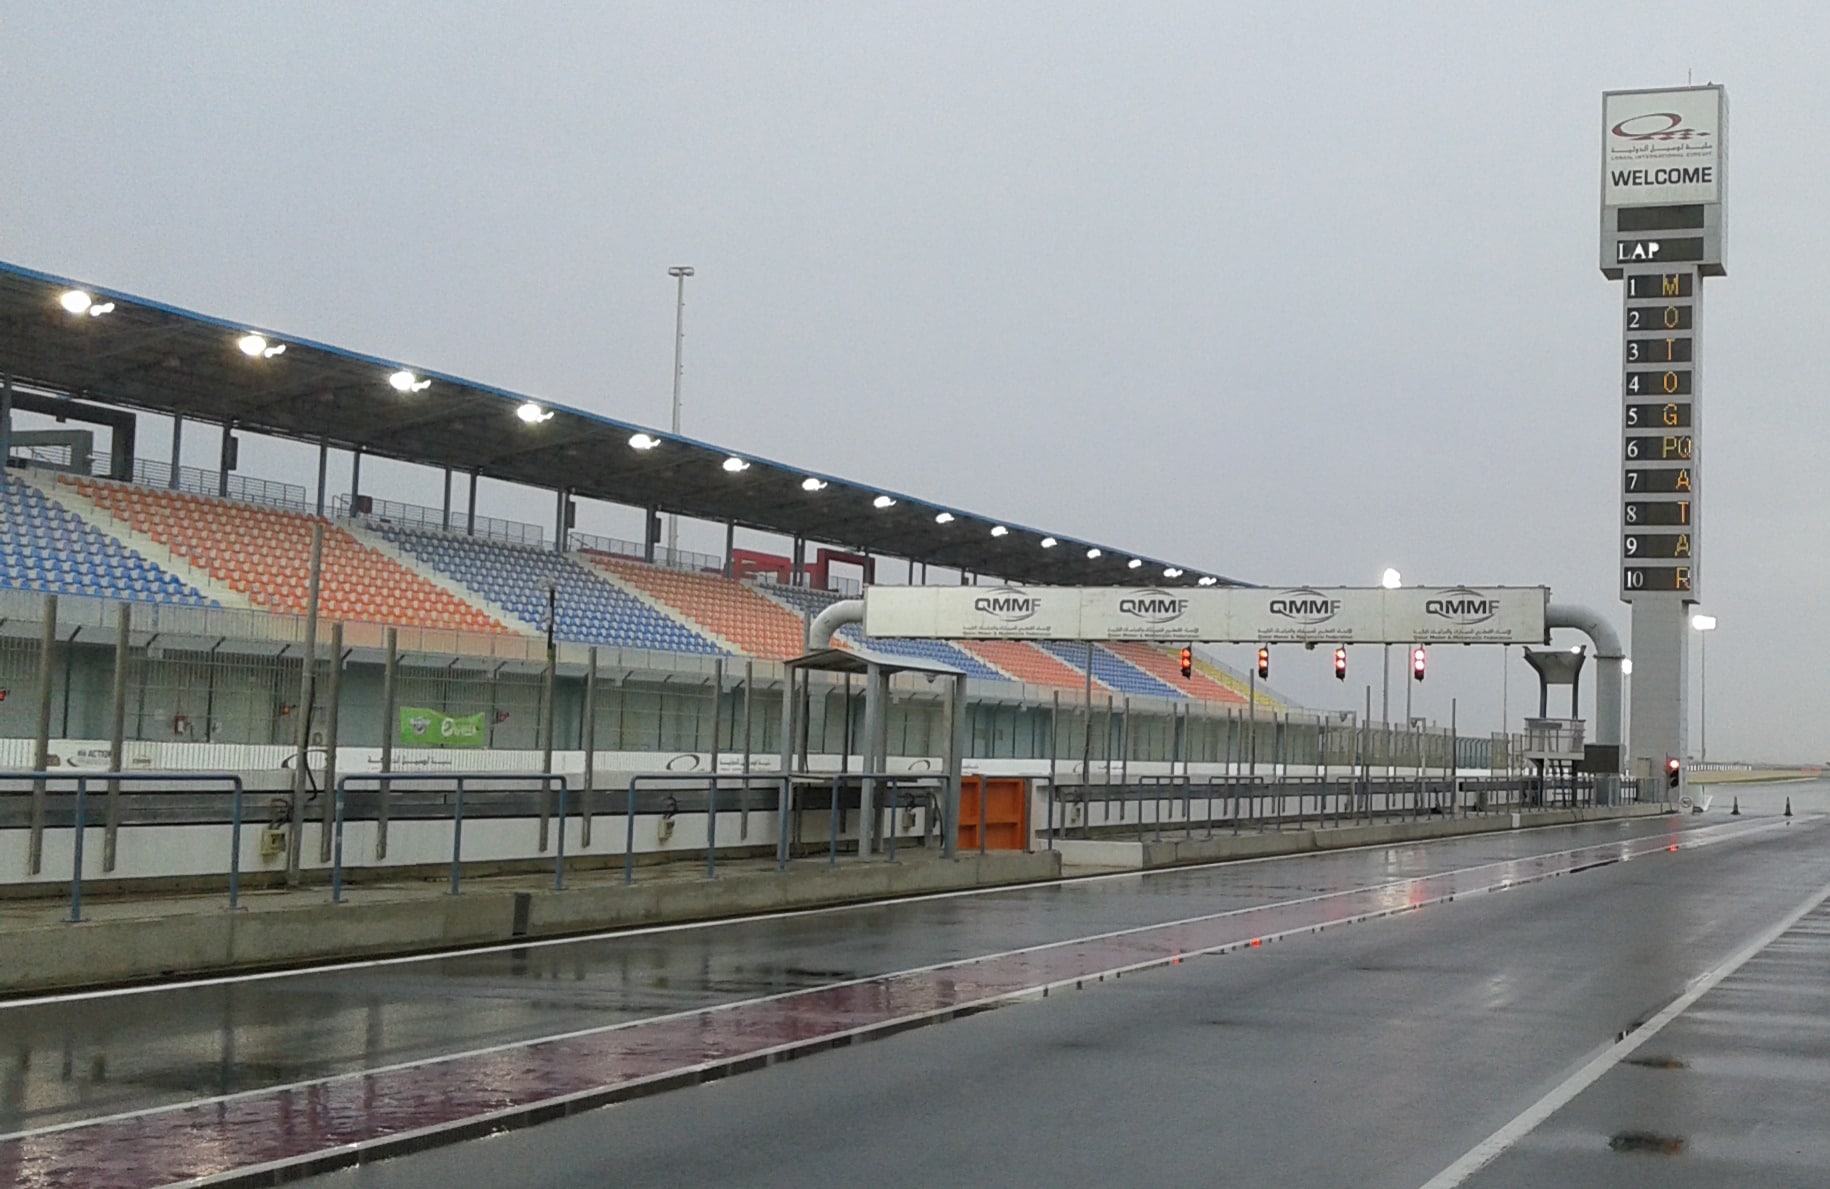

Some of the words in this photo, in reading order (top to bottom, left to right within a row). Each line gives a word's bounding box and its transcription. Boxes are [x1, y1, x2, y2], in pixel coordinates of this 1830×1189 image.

[1611, 166, 1712, 187] WELCOME
[1618, 241, 1660, 260] LAP
[1630, 278, 1636, 296] 1
[1629, 311, 1640, 328] 2
[1628, 343, 1639, 361] 3
[1628, 375, 1640, 393] 4
[1627, 407, 1638, 425] 5
[1627, 439, 1638, 458] 6
[1627, 472, 1638, 490] 7
[1626, 505, 1637, 523] 8
[1626, 537, 1637, 555] 9
[1626, 570, 1644, 588] 10
[975, 597, 1042, 613] QMMF
[1119, 599, 1189, 614] QMMF
[1269, 600, 1342, 614] QMMF
[1425, 600, 1500, 614] QMMF
